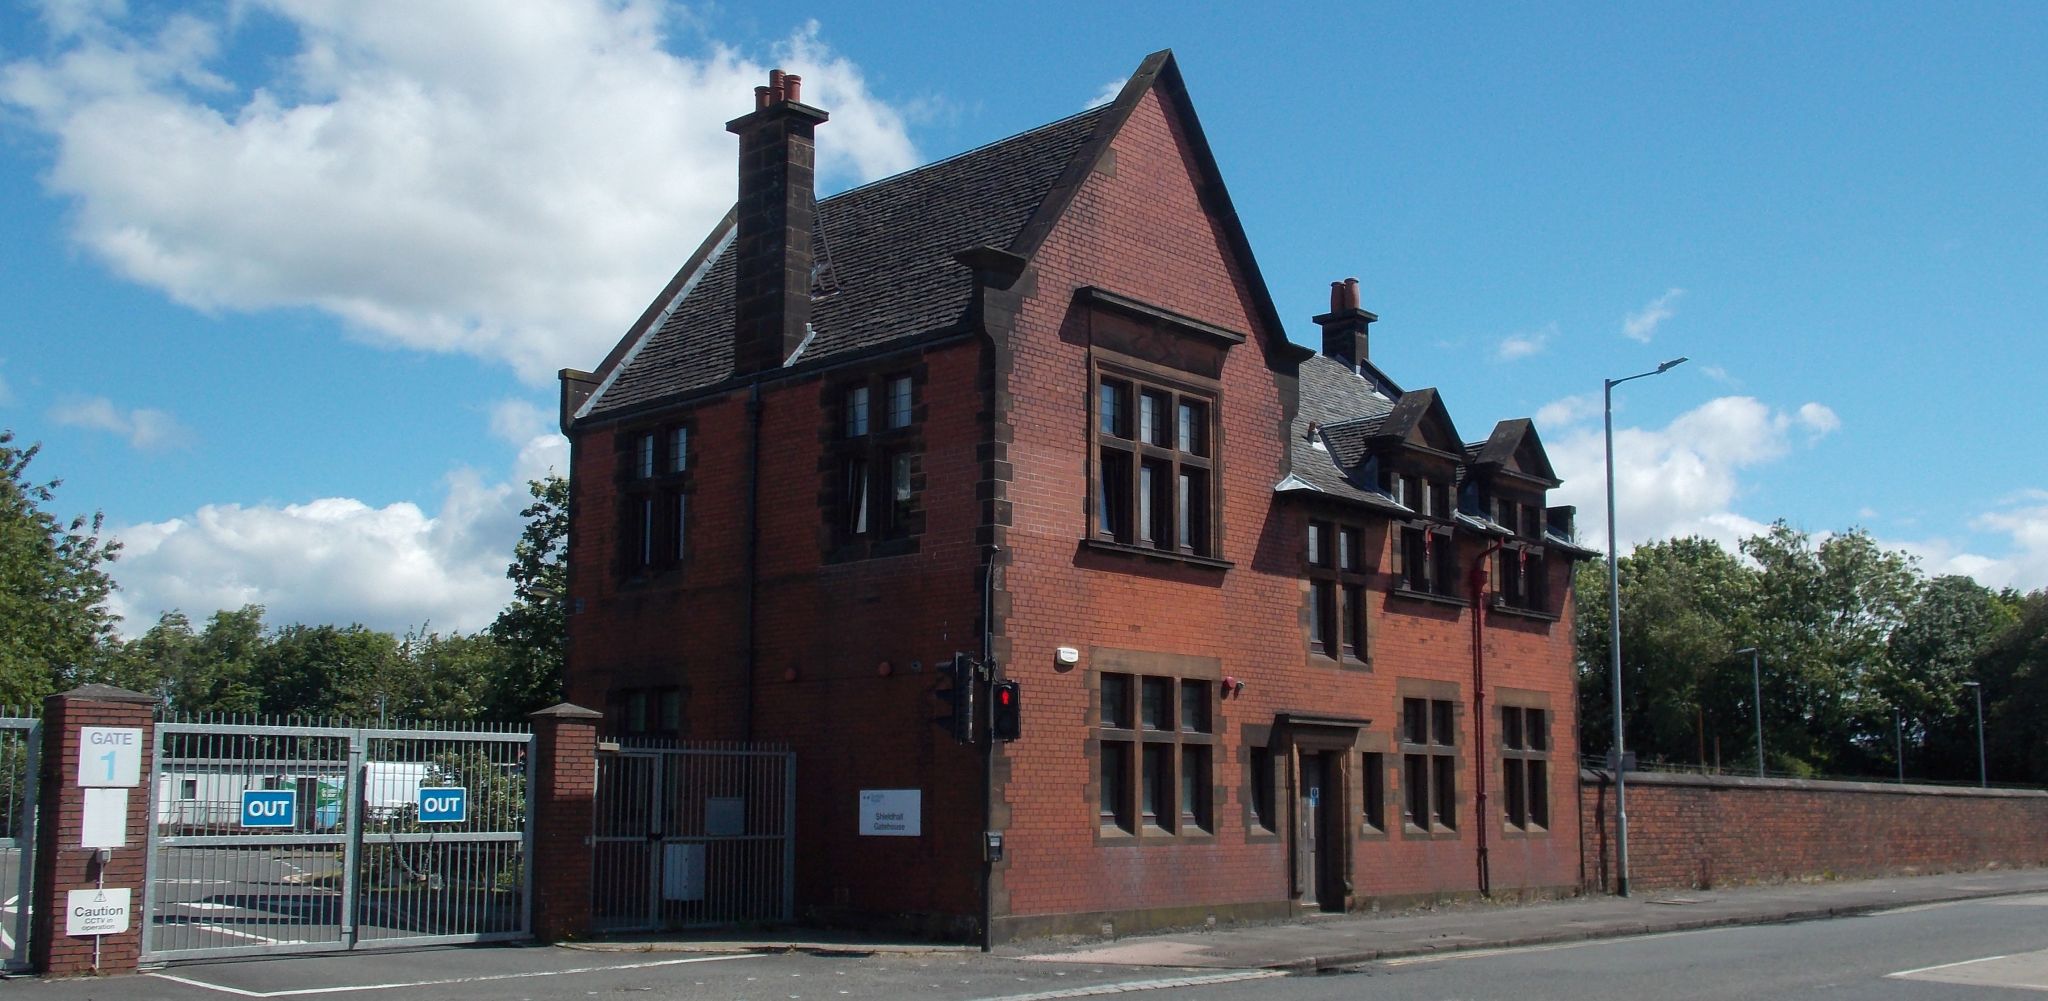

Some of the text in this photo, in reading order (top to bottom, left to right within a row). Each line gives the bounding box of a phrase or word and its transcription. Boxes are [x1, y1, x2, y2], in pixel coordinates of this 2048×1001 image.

[90, 732, 133, 745] GATE
[100, 751, 116, 781] 1
[249, 800, 290, 817] OUT
[424, 797, 461, 813] OUT
[74, 906, 124, 917] Caution
